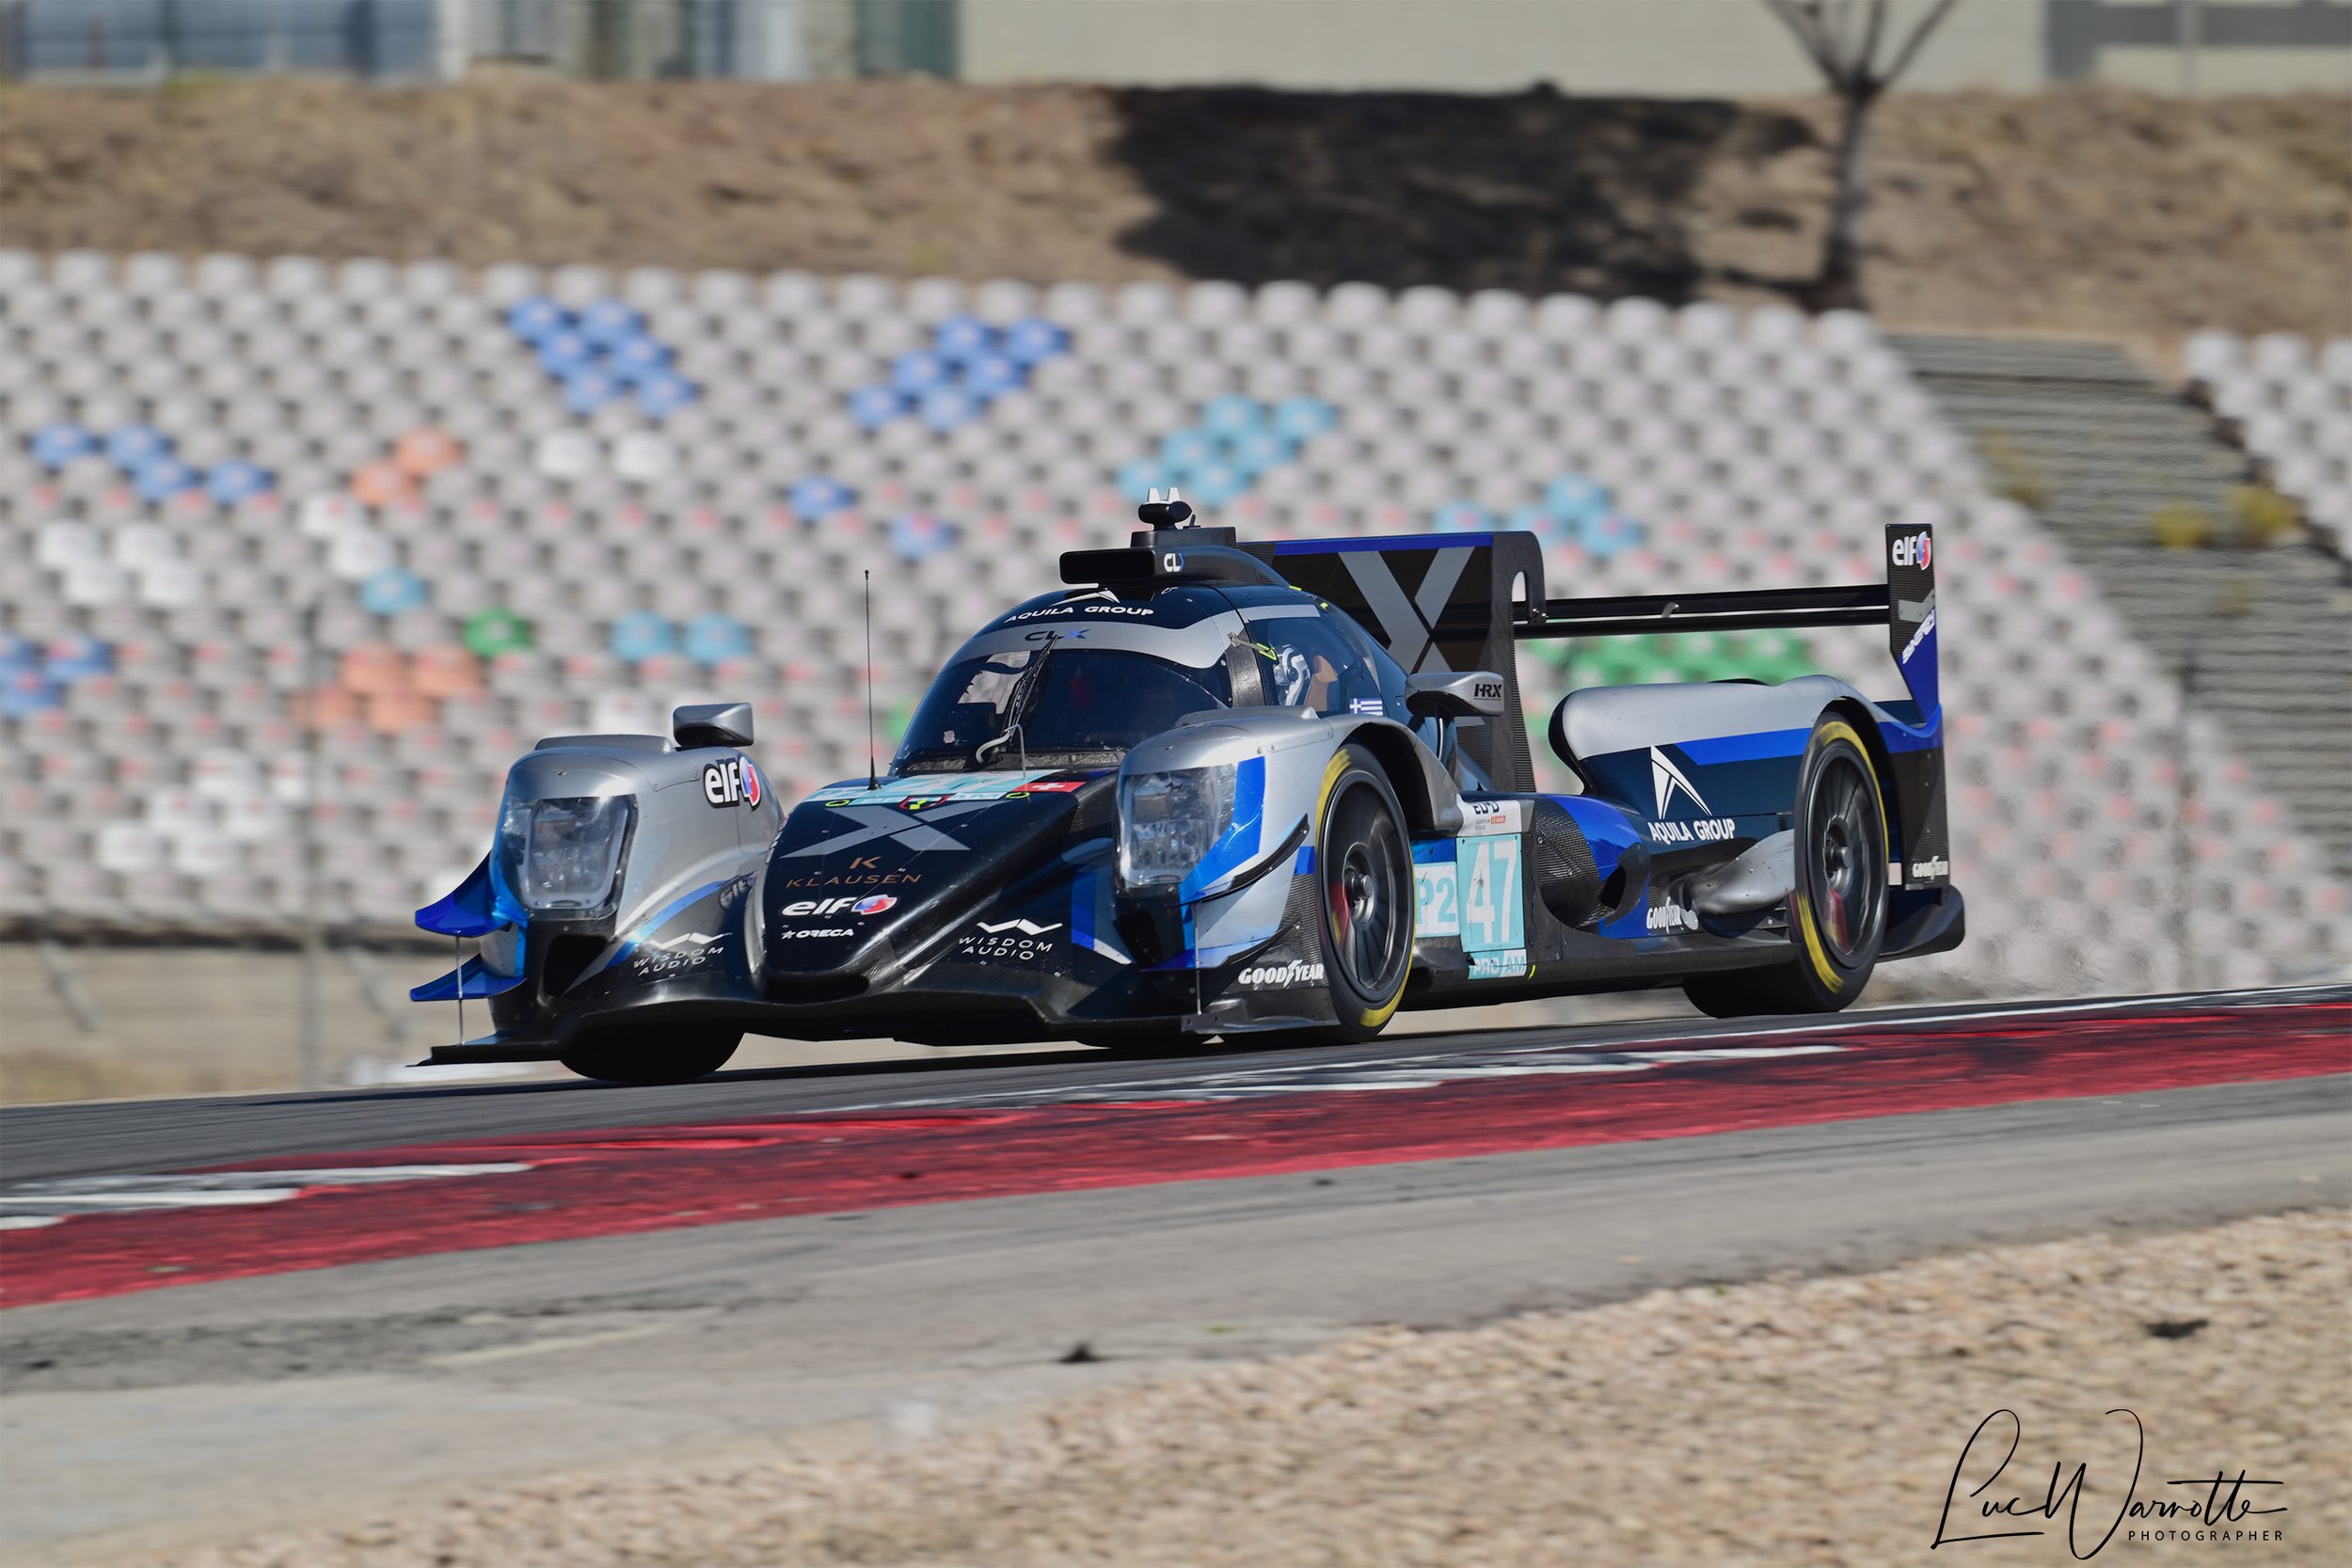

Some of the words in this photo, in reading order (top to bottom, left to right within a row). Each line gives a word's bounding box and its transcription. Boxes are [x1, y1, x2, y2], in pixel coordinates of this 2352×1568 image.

[1892, 535, 1917, 566] elf
[1004, 606, 1073, 624] AQUILA
[1084, 606, 1154, 616] GROUP
[1473, 683, 1502, 698] HRX
[704, 761, 740, 804] elf
[1647, 821, 1694, 845] AQUILA
[1692, 818, 1736, 841] GROUP
[786, 874, 922, 888] KLAUSEN
[1467, 840, 1517, 943] 47
[782, 896, 858, 916] elf
[796, 928, 854, 939] ORECA
[959, 937, 1053, 953] WISDOM
[961, 945, 1034, 960] AUDIO
[633, 946, 724, 969] WISDOM
[638, 957, 707, 977] AUDIO
[1237, 959, 1325, 989] GOODYEAR
